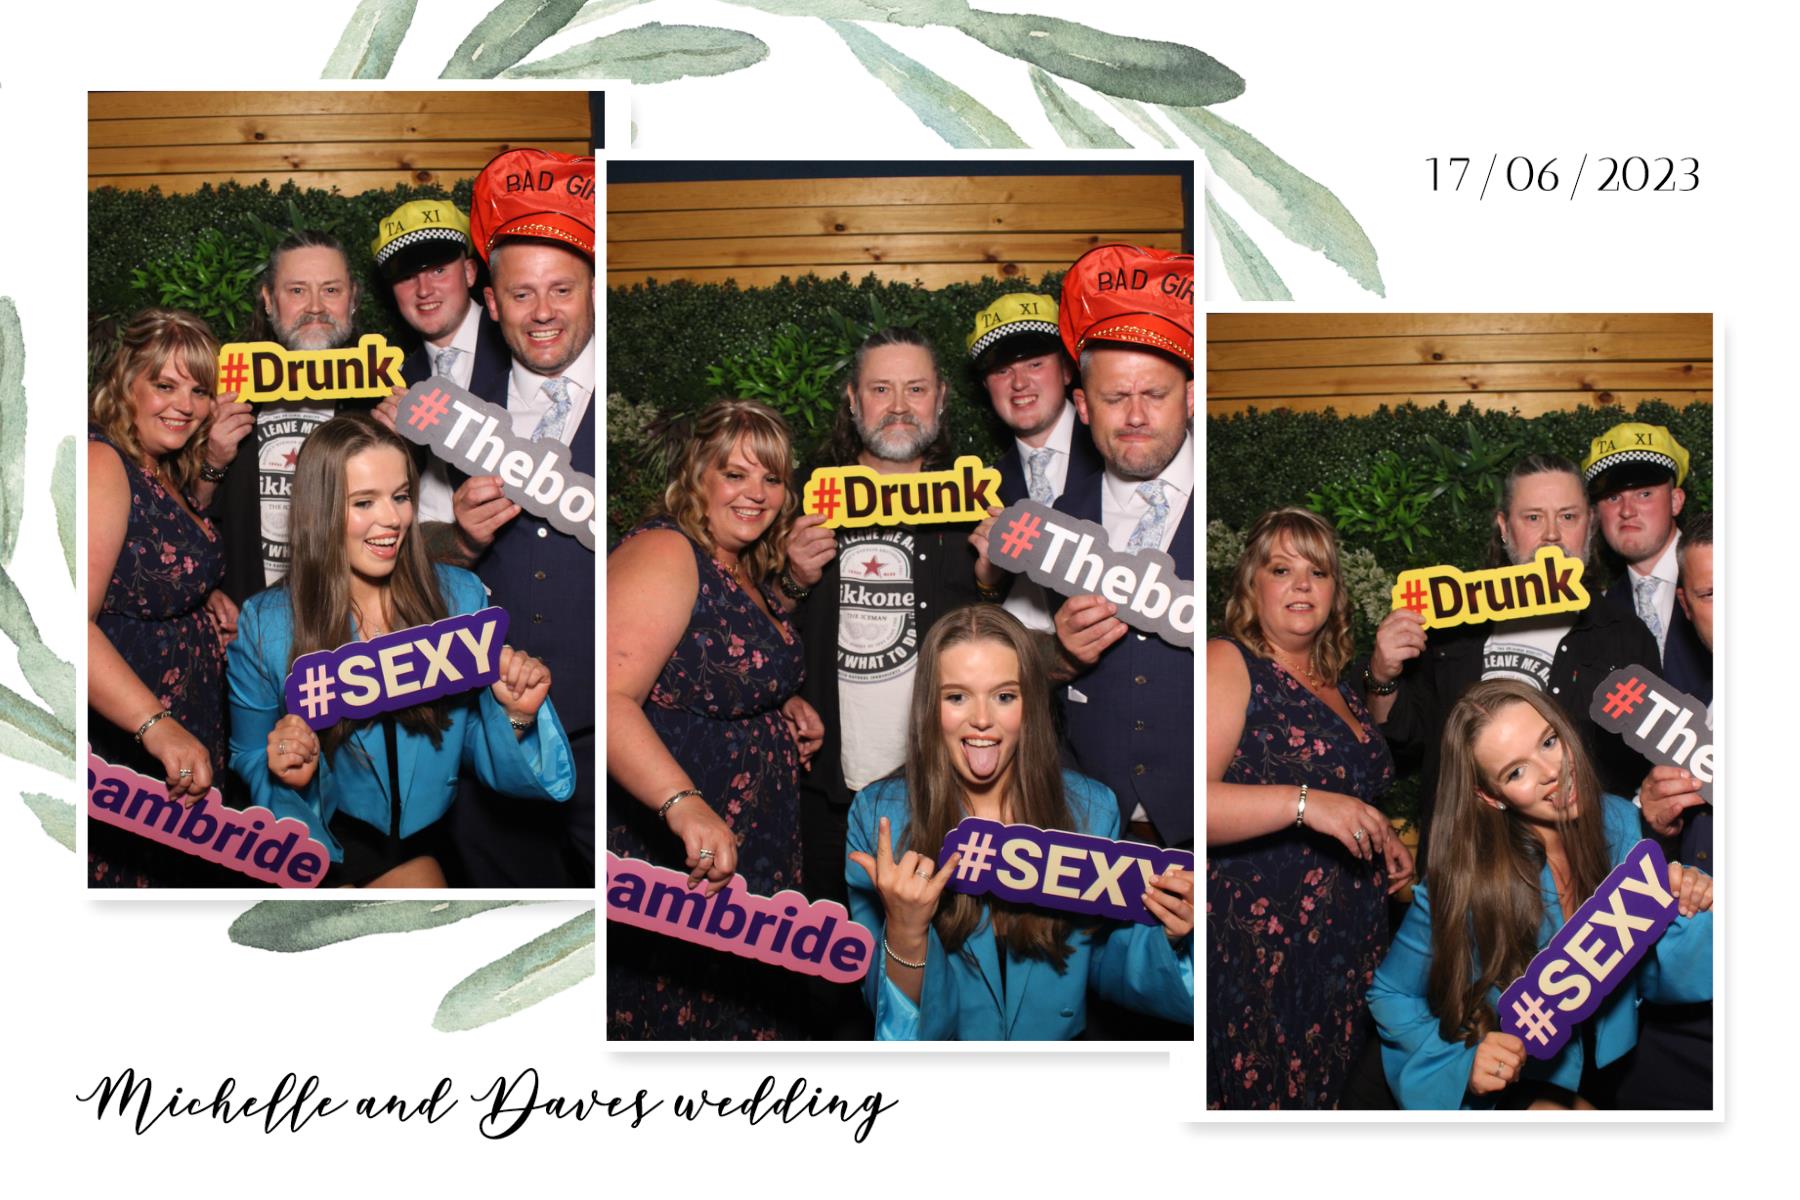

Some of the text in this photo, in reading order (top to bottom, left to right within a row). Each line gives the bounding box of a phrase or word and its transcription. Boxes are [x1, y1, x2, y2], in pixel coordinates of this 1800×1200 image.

[506, 170, 554, 193] BAD
[1097, 268, 1194, 304] BAD GIR
[220, 344, 395, 394] #Drunk
[262, 420, 298, 438] LEAVE
[812, 466, 992, 520] #Drunk
[1000, 511, 1194, 633] #Thebo
[1400, 556, 1580, 619] #Drunk
[297, 620, 498, 721] #SEXY
[844, 654, 885, 670] WHAT
[886, 646, 908, 664] TO
[902, 628, 917, 648] DO
[1483, 654, 1520, 669] LEAVE
[1520, 657, 1541, 673] ME
[1602, 676, 1713, 783] #The
[607, 872, 867, 973] ambride
[1511, 852, 1675, 1046] #SEXY
